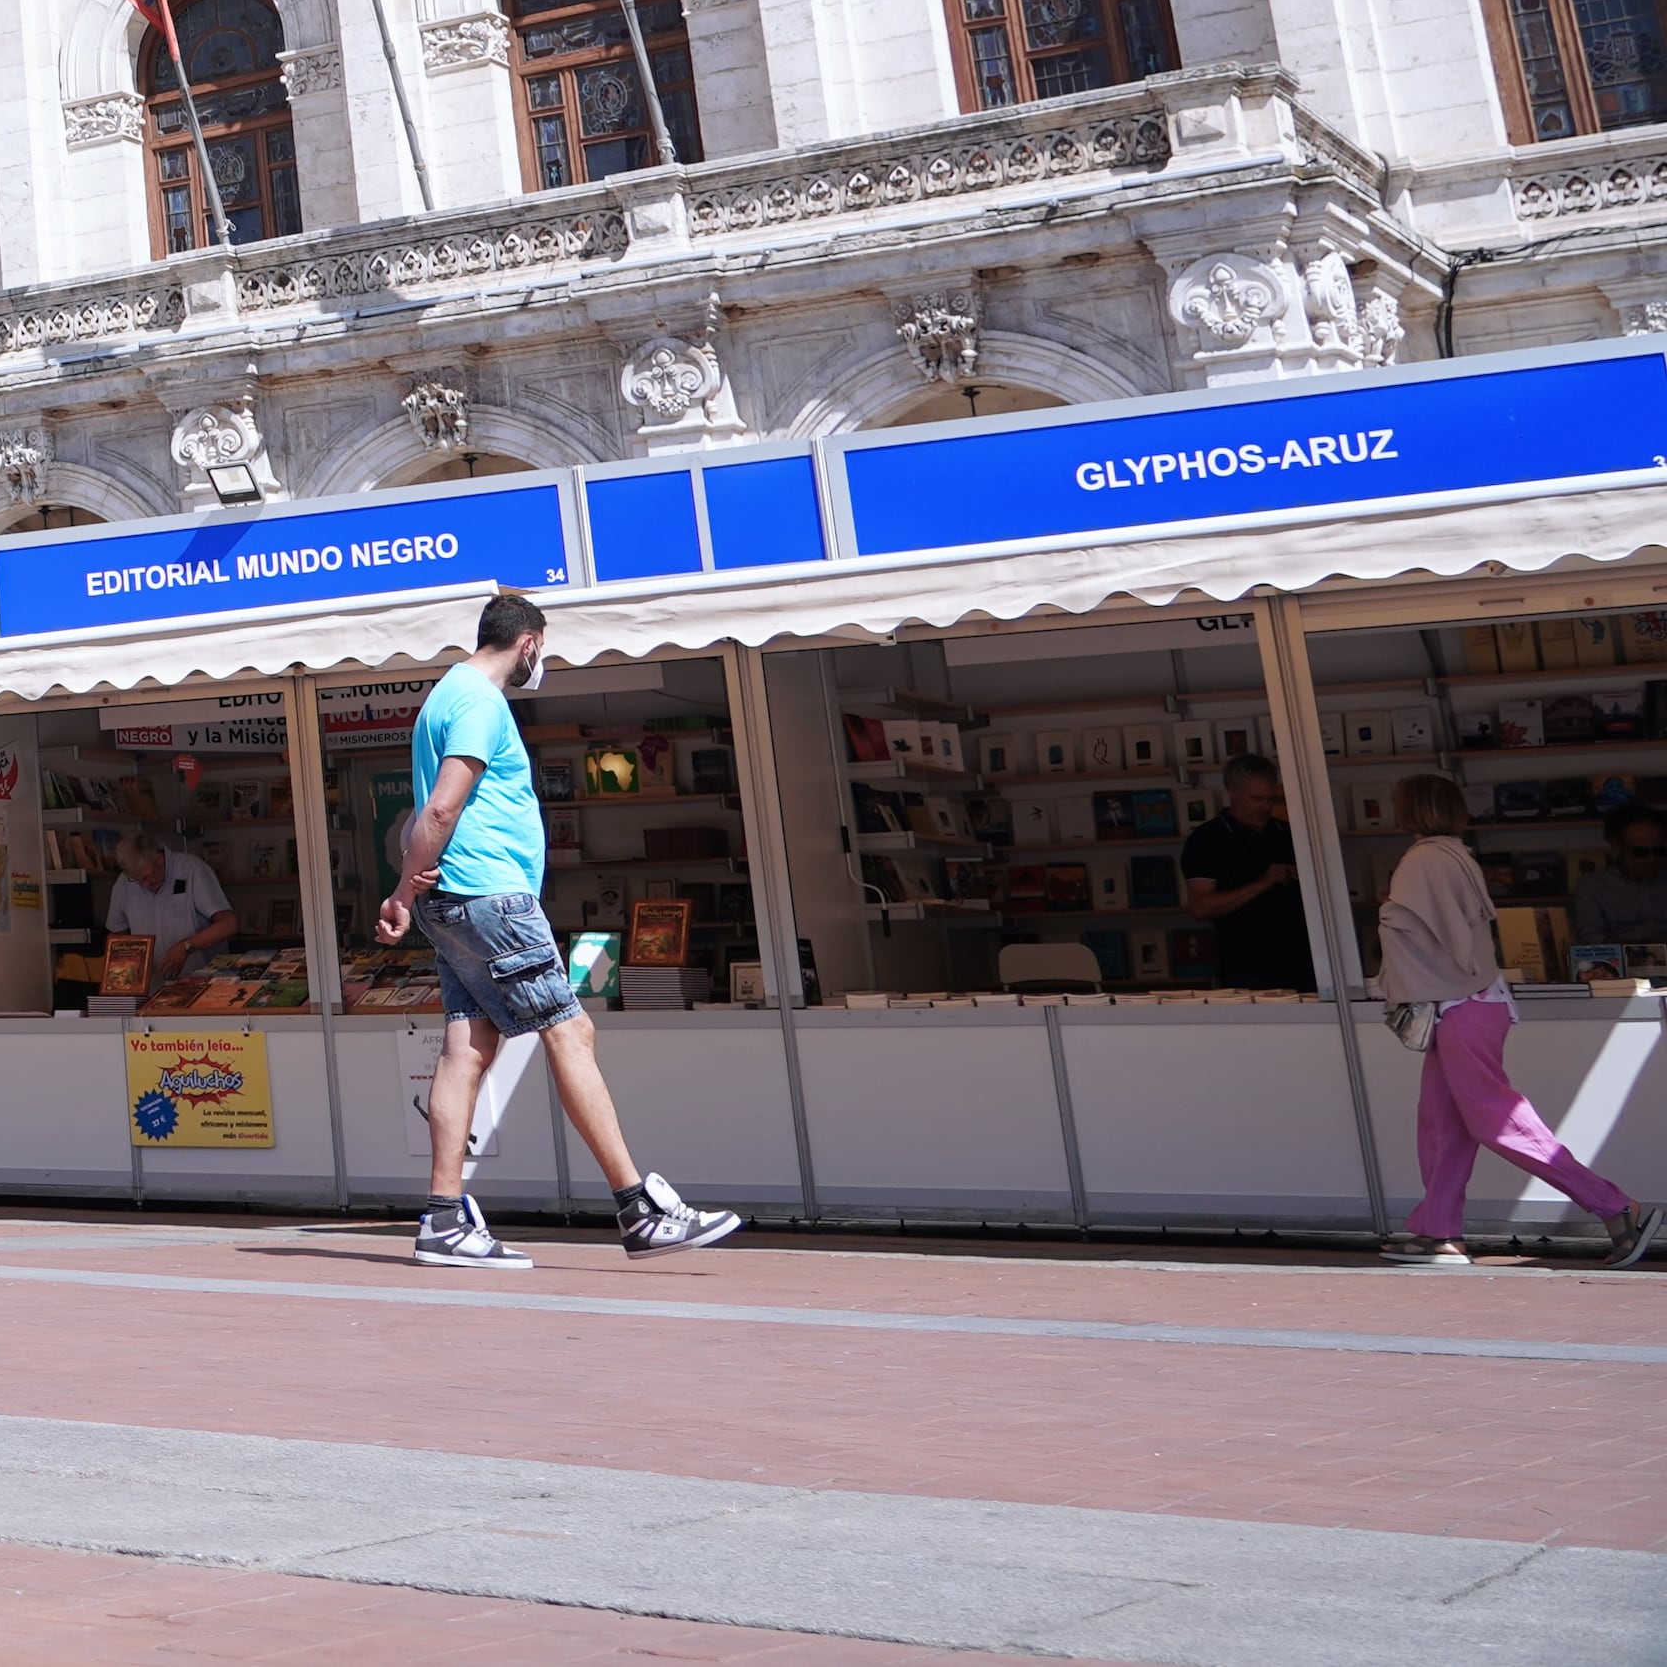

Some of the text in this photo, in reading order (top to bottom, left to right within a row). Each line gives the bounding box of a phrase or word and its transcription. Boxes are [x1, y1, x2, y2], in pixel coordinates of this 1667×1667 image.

[1075, 428, 1399, 492] GLYPHOS-ARUZ
[86, 533, 459, 598] EDITORIAL MUNDO NEGRO
[546, 567, 566, 583] 34
[118, 730, 171, 744] NEGRO
[187, 731, 199, 746] y
[205, 728, 222, 744] la
[339, 731, 407, 746] MISIONEROS
[378, 781, 412, 796] MUN
[131, 1039, 243, 1052] Yo también leía...
[159, 1069, 243, 1095] Aguiluchos
[203, 1109, 212, 1117] La
[213, 1109, 236, 1117] revista
